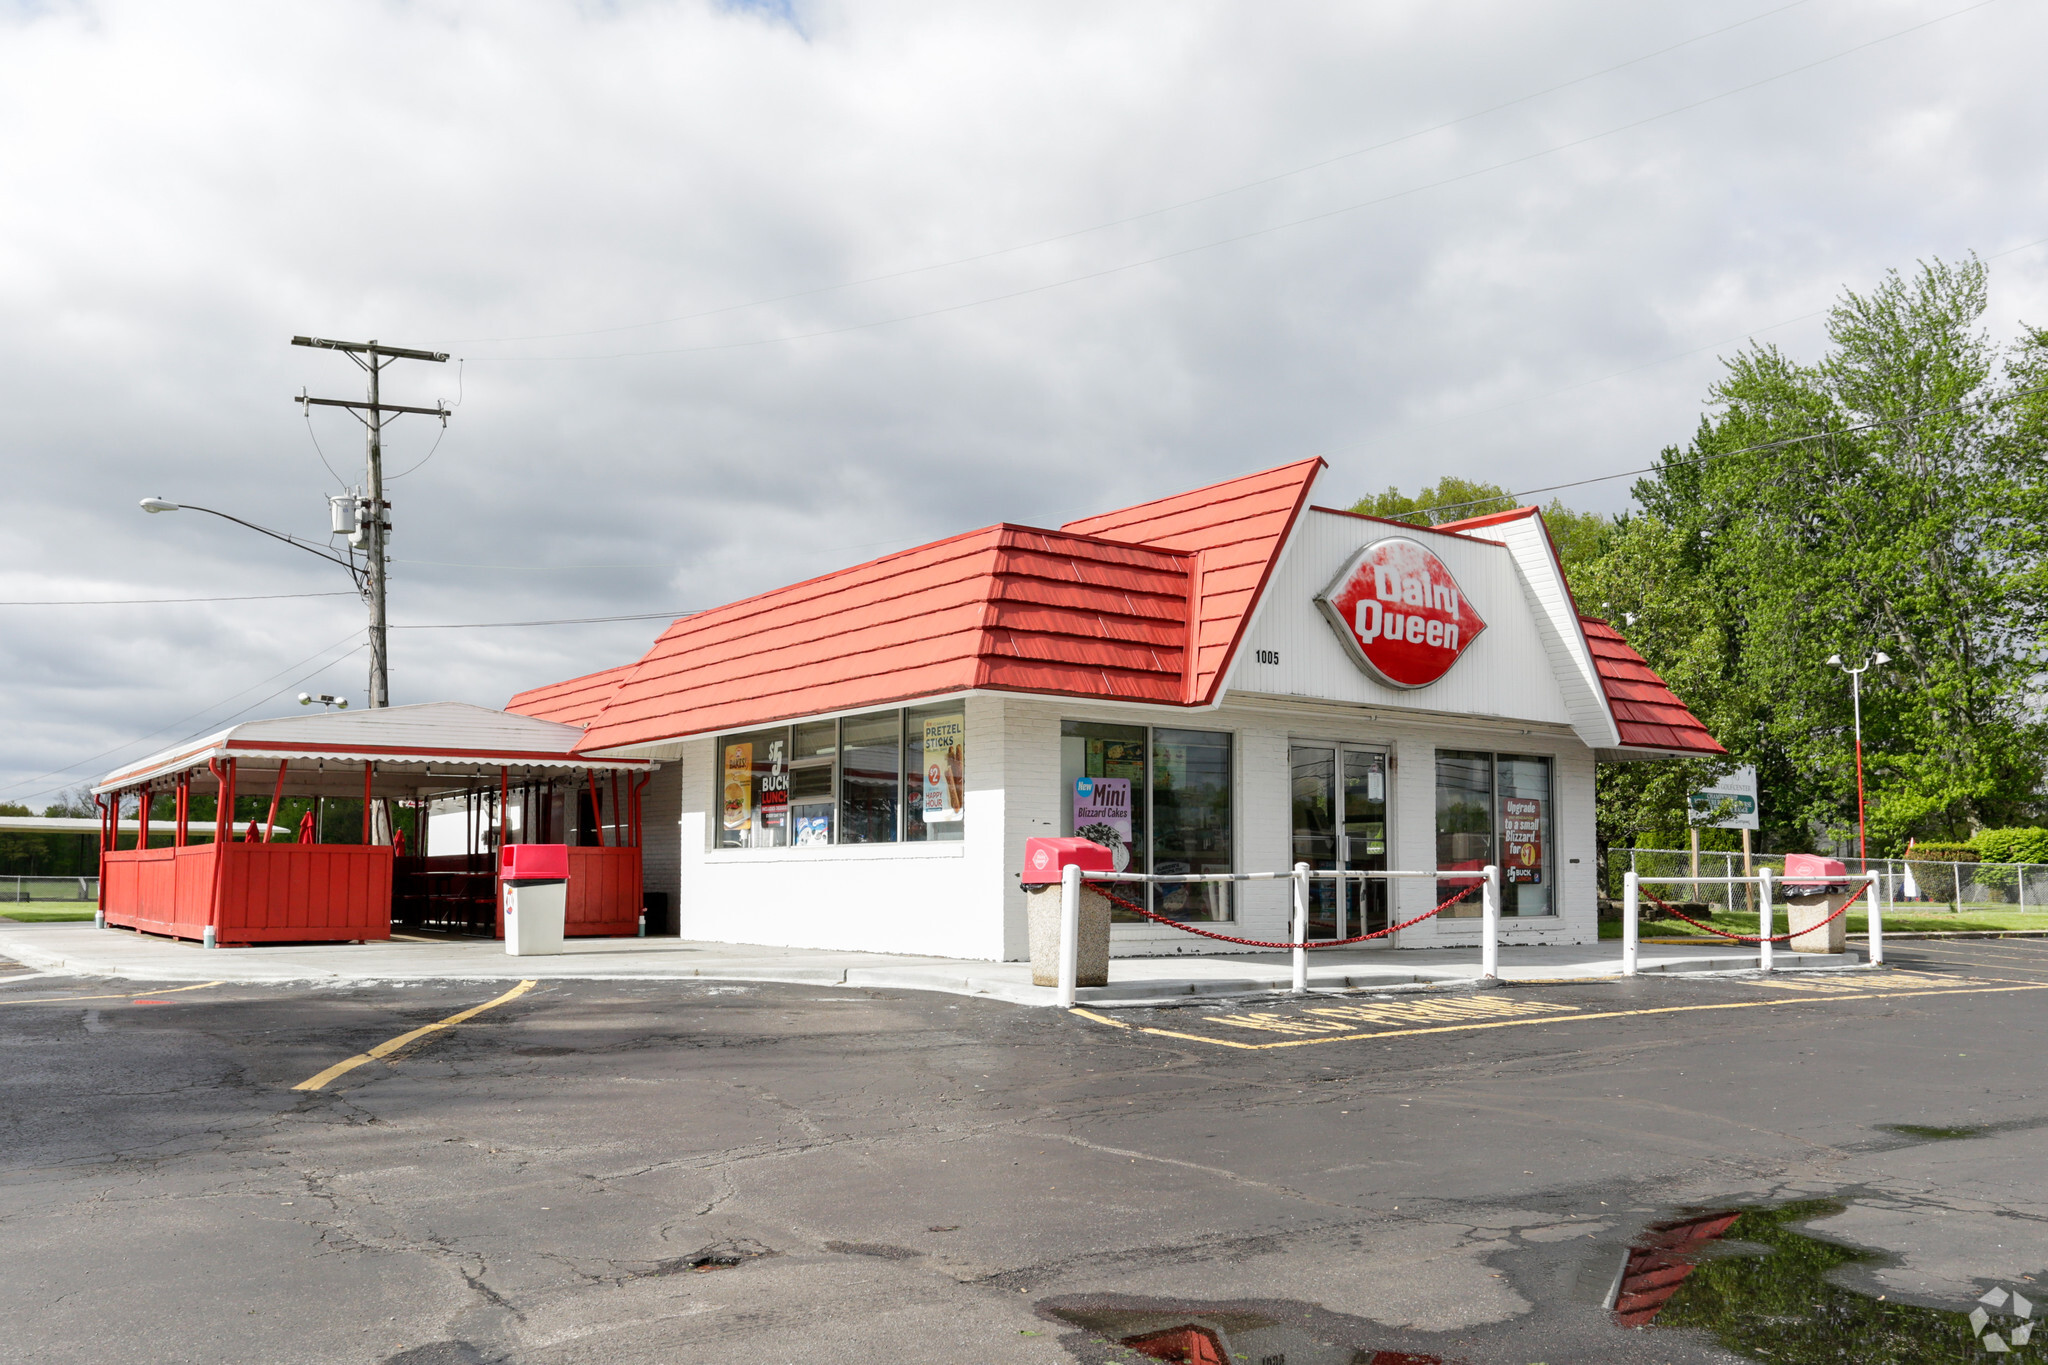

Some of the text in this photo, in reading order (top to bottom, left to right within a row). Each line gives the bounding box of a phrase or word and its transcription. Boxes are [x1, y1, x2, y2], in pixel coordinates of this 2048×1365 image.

[1374, 565, 1460, 620] Dairy
[1355, 599, 1459, 650] Queen
[1256, 650, 1279, 665] 1005
[926, 723, 961, 737] PRETZEL
[926, 736, 954, 749] STICKS
[769, 740, 784, 776] $5
[930, 767, 939, 782] $2
[1077, 781, 1093, 791] New
[926, 791, 942, 800] HAPPY
[1093, 783, 1126, 806] Mini
[926, 799, 942, 808] HOUR
[1507, 801, 1536, 815] Upgrade
[1078, 807, 1128, 818] Blizzard Cakes
[1505, 818, 1539, 831] to a small
[1506, 829, 1536, 843] Blizzard
[1510, 842, 1521, 855] for
[1516, 869, 1532, 877] BUCK
